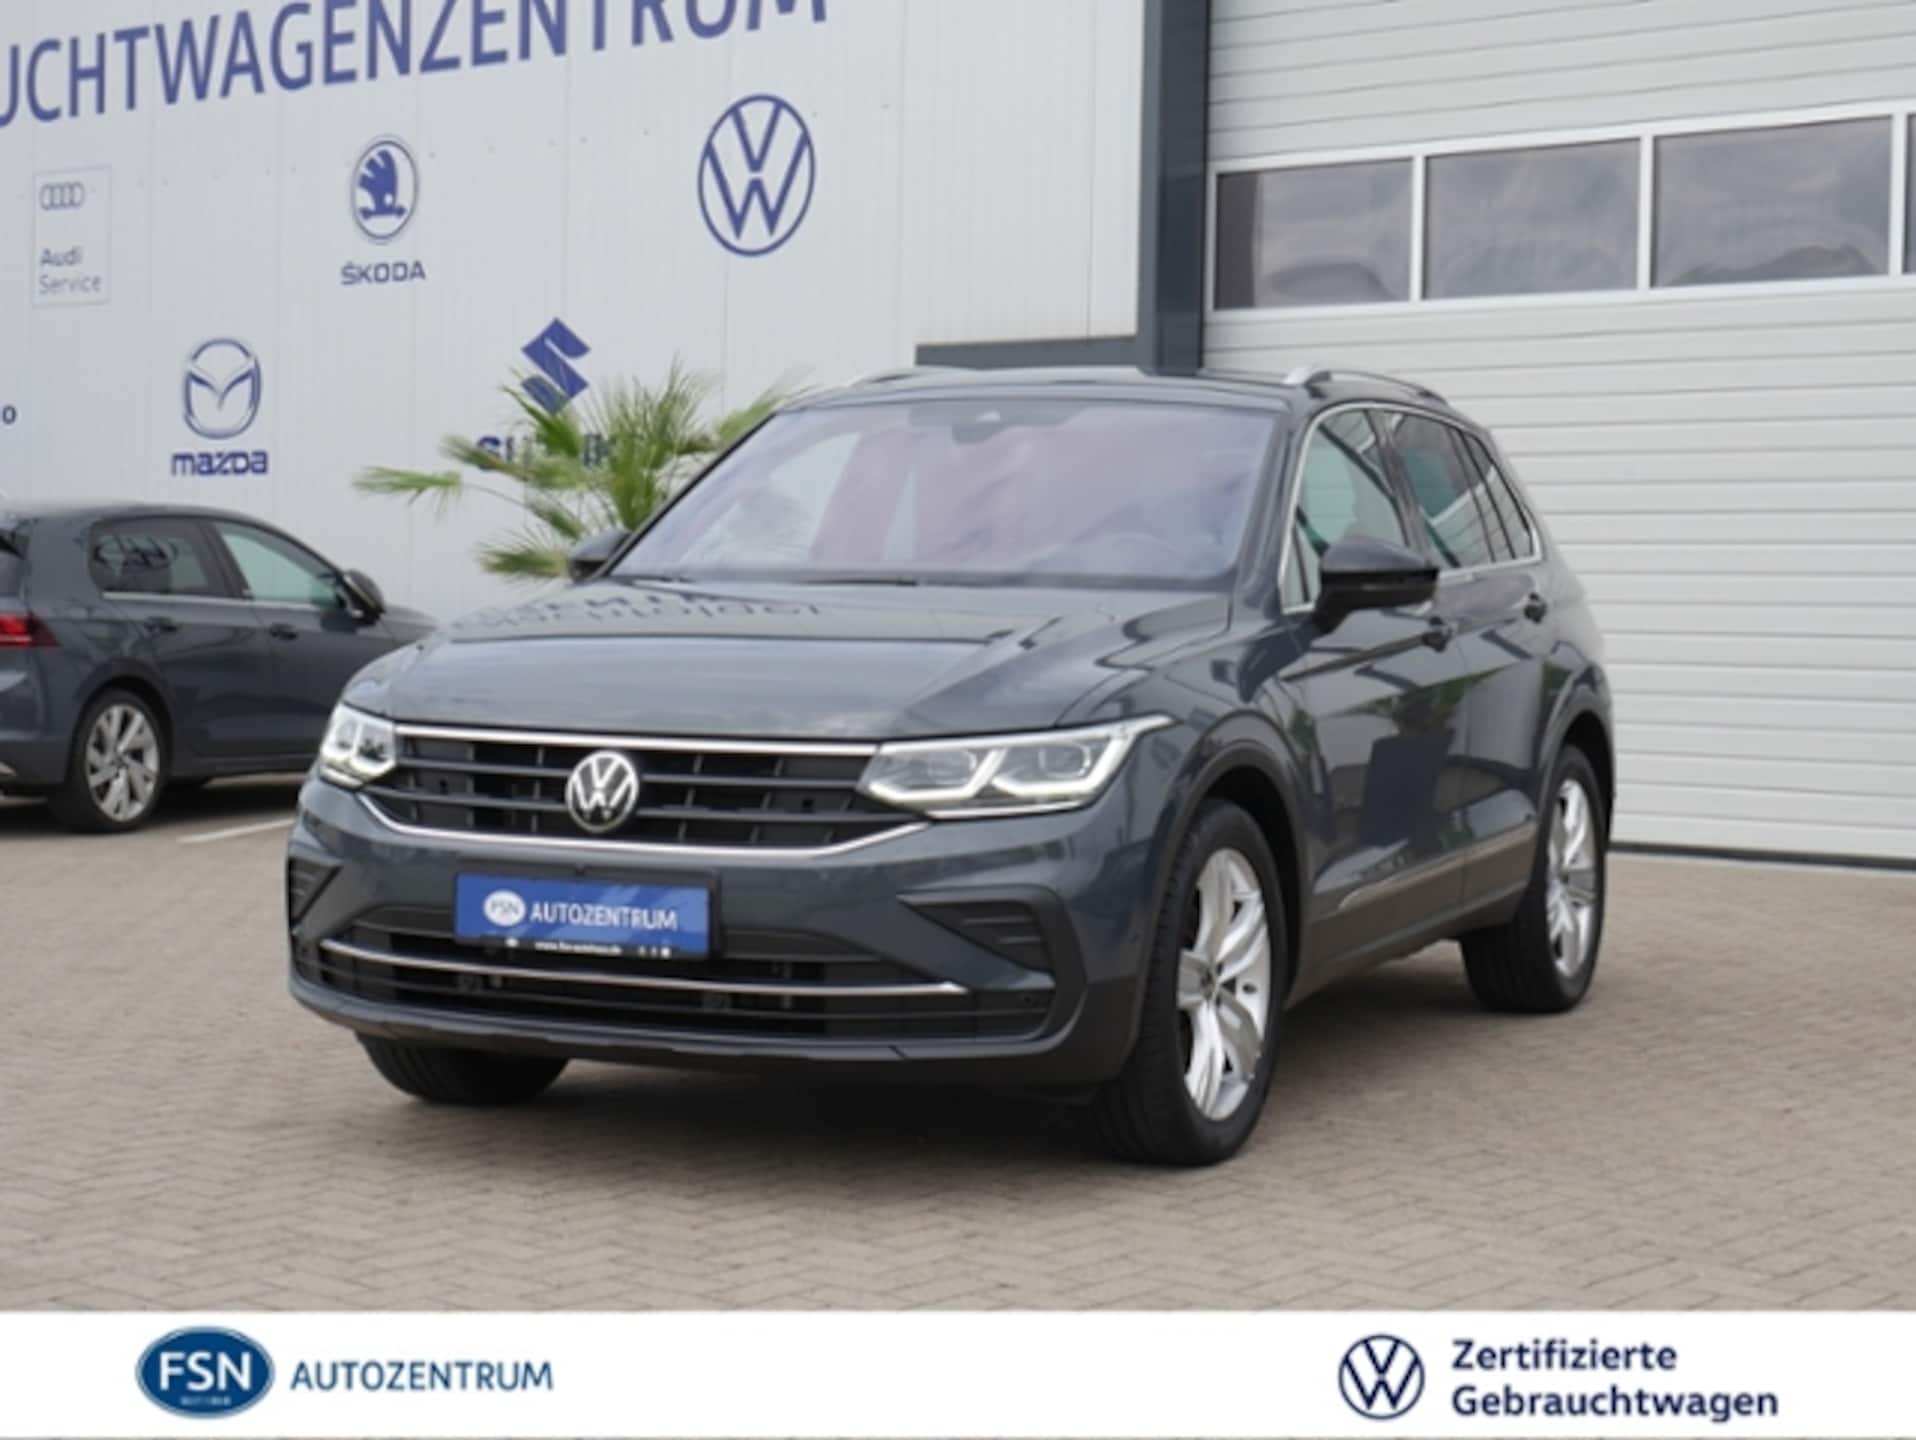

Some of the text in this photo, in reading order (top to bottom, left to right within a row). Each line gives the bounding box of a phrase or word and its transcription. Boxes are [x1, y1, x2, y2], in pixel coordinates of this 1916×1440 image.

[0, 0, 827, 128] UCHTWAGENZEN
[40, 247, 81, 267] Audi
[39, 274, 102, 295] Service
[529, 902, 679, 931] AUTOZENTRUM
